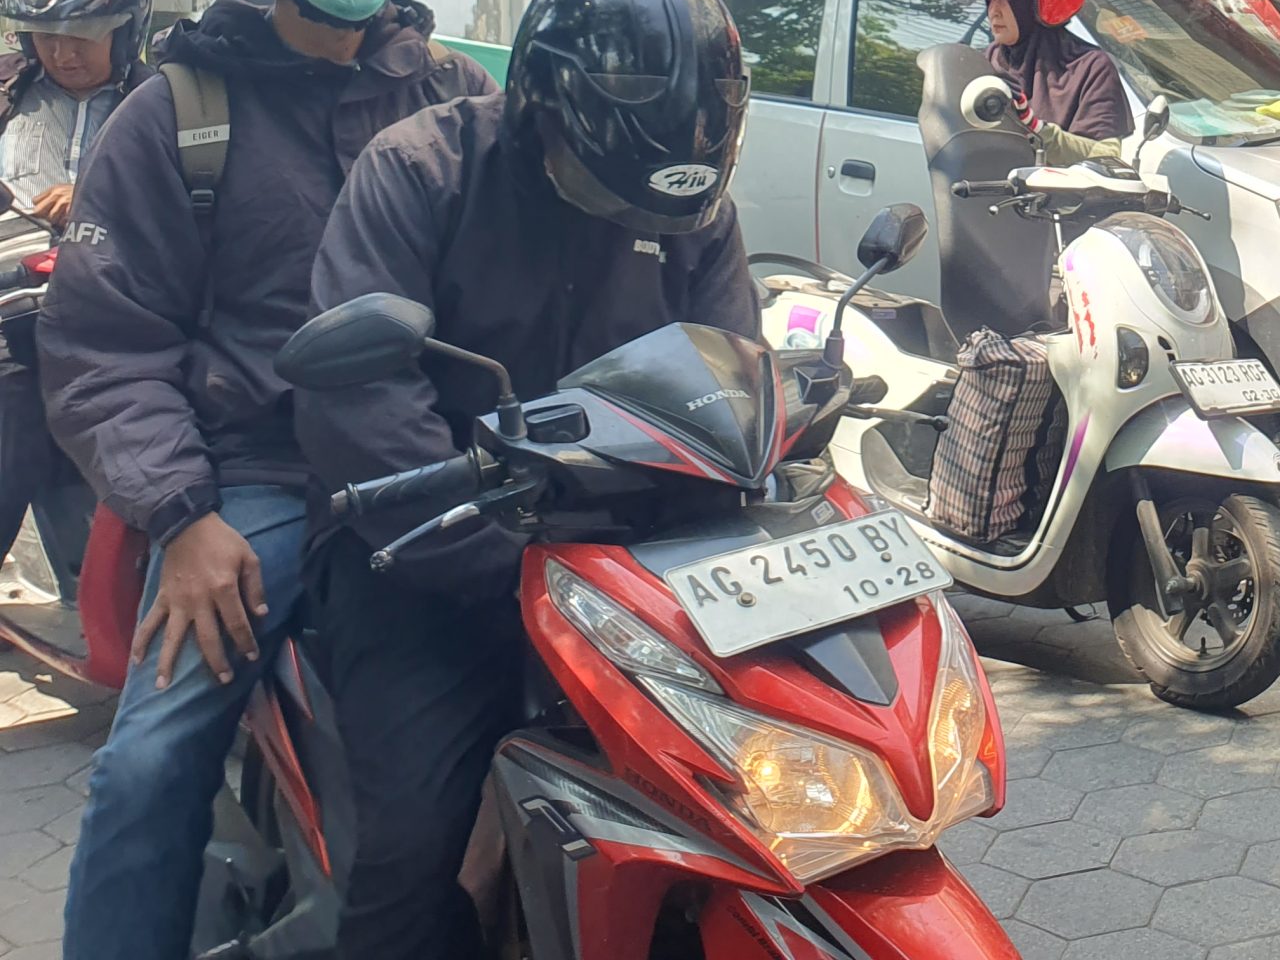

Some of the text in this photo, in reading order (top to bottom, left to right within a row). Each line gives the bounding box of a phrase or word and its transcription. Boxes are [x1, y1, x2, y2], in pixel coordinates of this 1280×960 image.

[192, 129, 219, 141] EIGER
[1201, 365, 1241, 385] 3123
[686, 388, 751, 411] HONDA
[686, 516, 909, 608] AG 2450 BY
